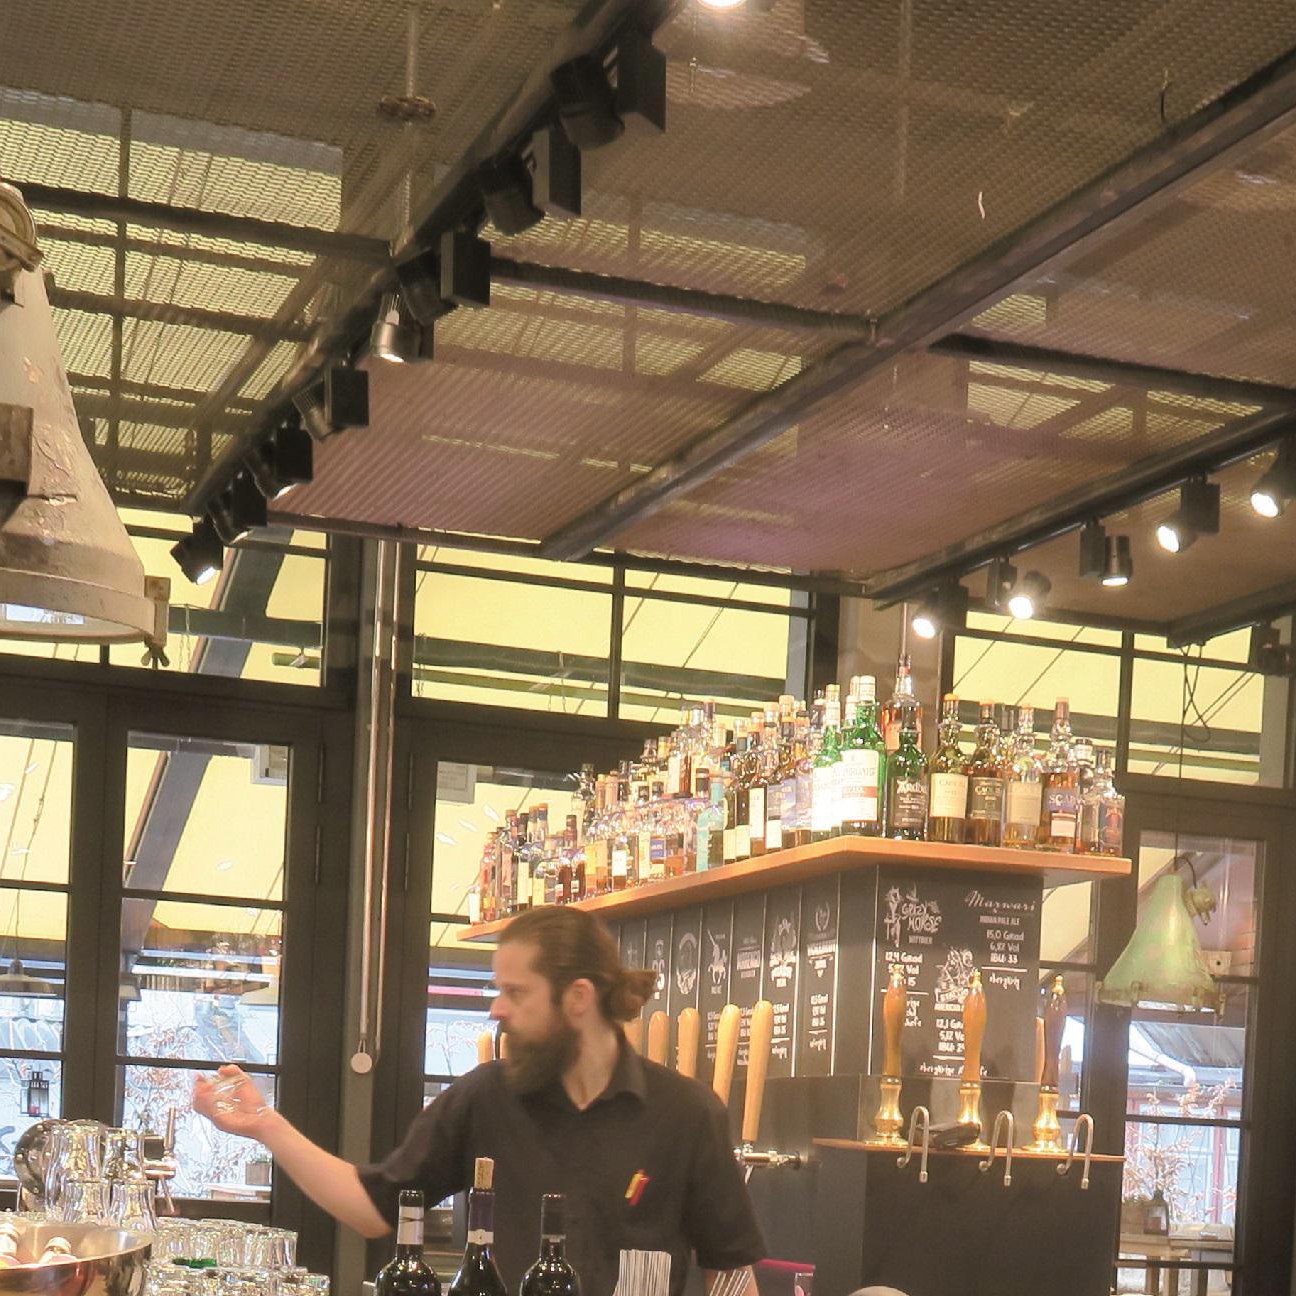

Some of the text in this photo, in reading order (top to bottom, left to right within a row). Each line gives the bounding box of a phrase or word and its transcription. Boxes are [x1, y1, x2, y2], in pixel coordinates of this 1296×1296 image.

[907, 913, 942, 934] HORSE
[1003, 931, 1024, 941] Grad
[1007, 943, 1020, 953] Vol
[900, 952, 923, 963] Grad
[906, 964, 919, 975] Vol
